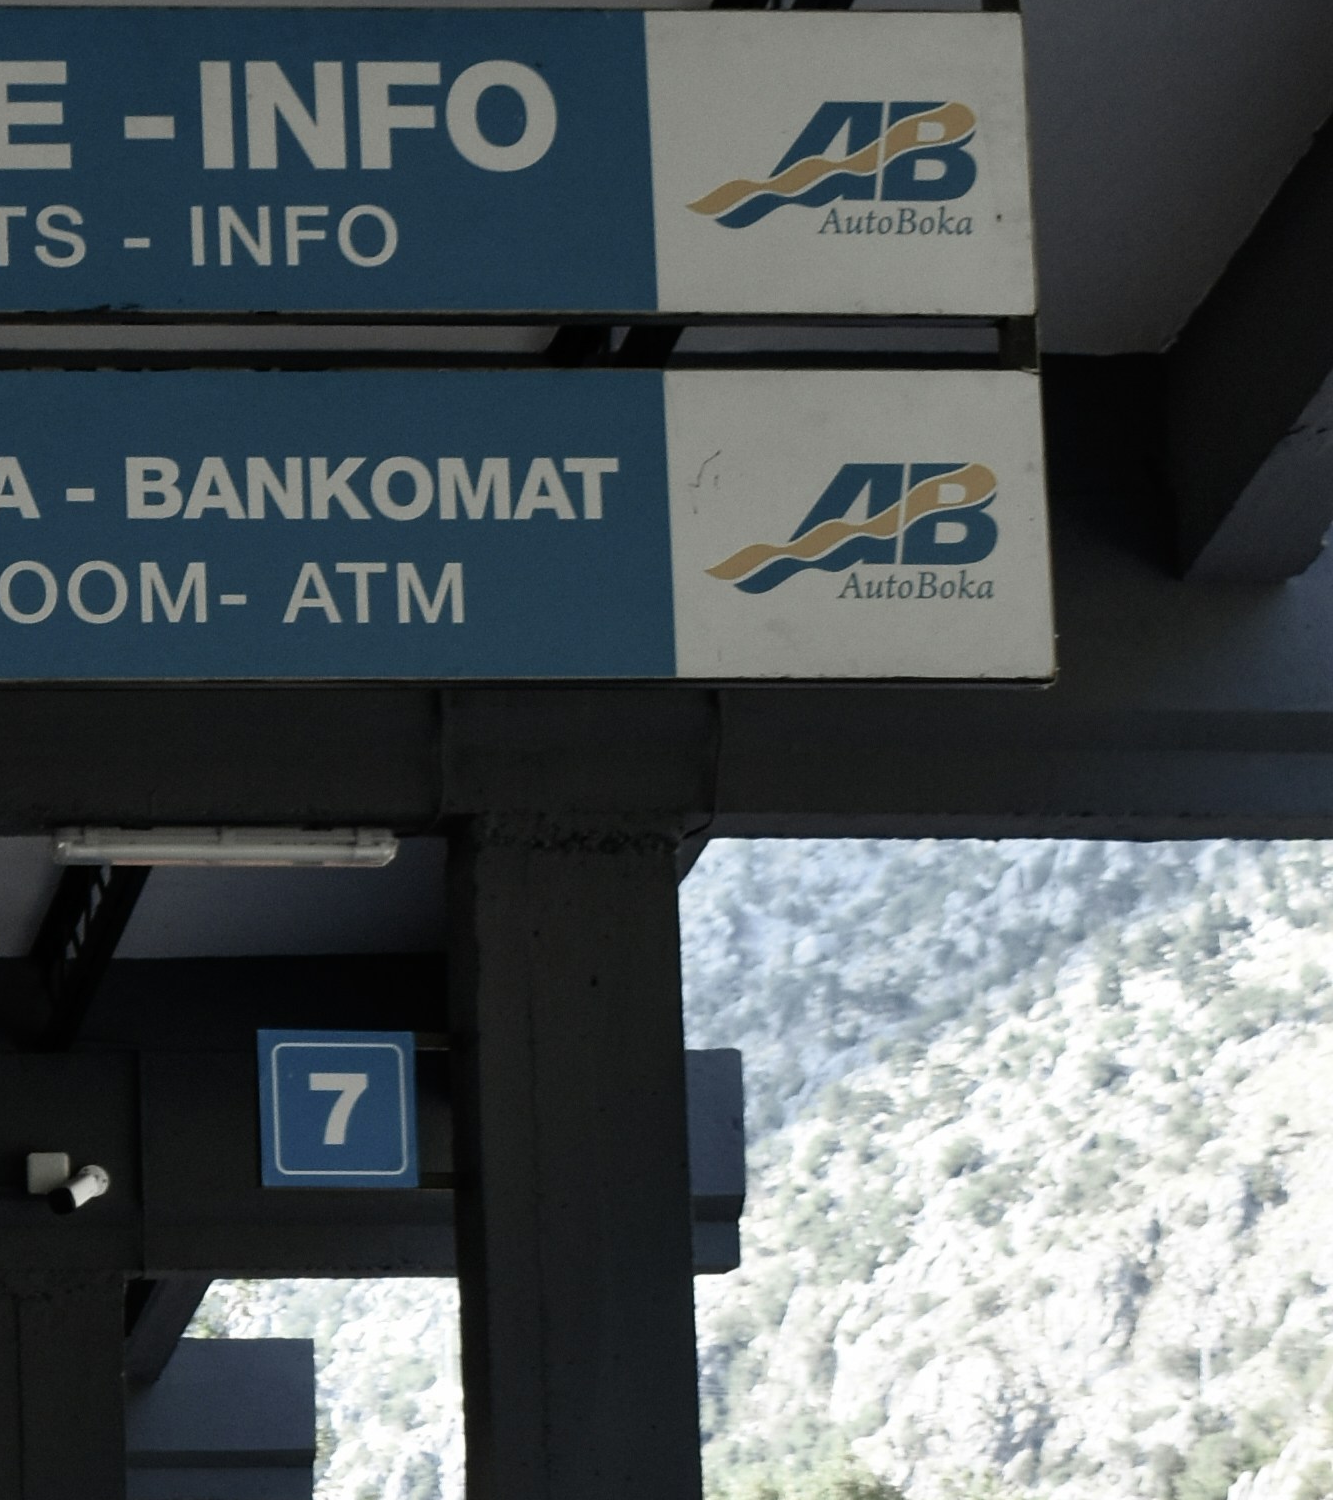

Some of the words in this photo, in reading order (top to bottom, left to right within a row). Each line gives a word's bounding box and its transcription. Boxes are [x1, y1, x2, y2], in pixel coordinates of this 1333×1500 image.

[733, 101, 978, 214] AB
[191, 205, 397, 267] INFO
[818, 207, 974, 236] AutoBoka
[126, 457, 618, 520] BANKOMAT
[753, 463, 999, 578] AB
[284, 563, 464, 623] ATM
[837, 571, 995, 601] AutoBoka
[310, 1073, 367, 1144] 7
